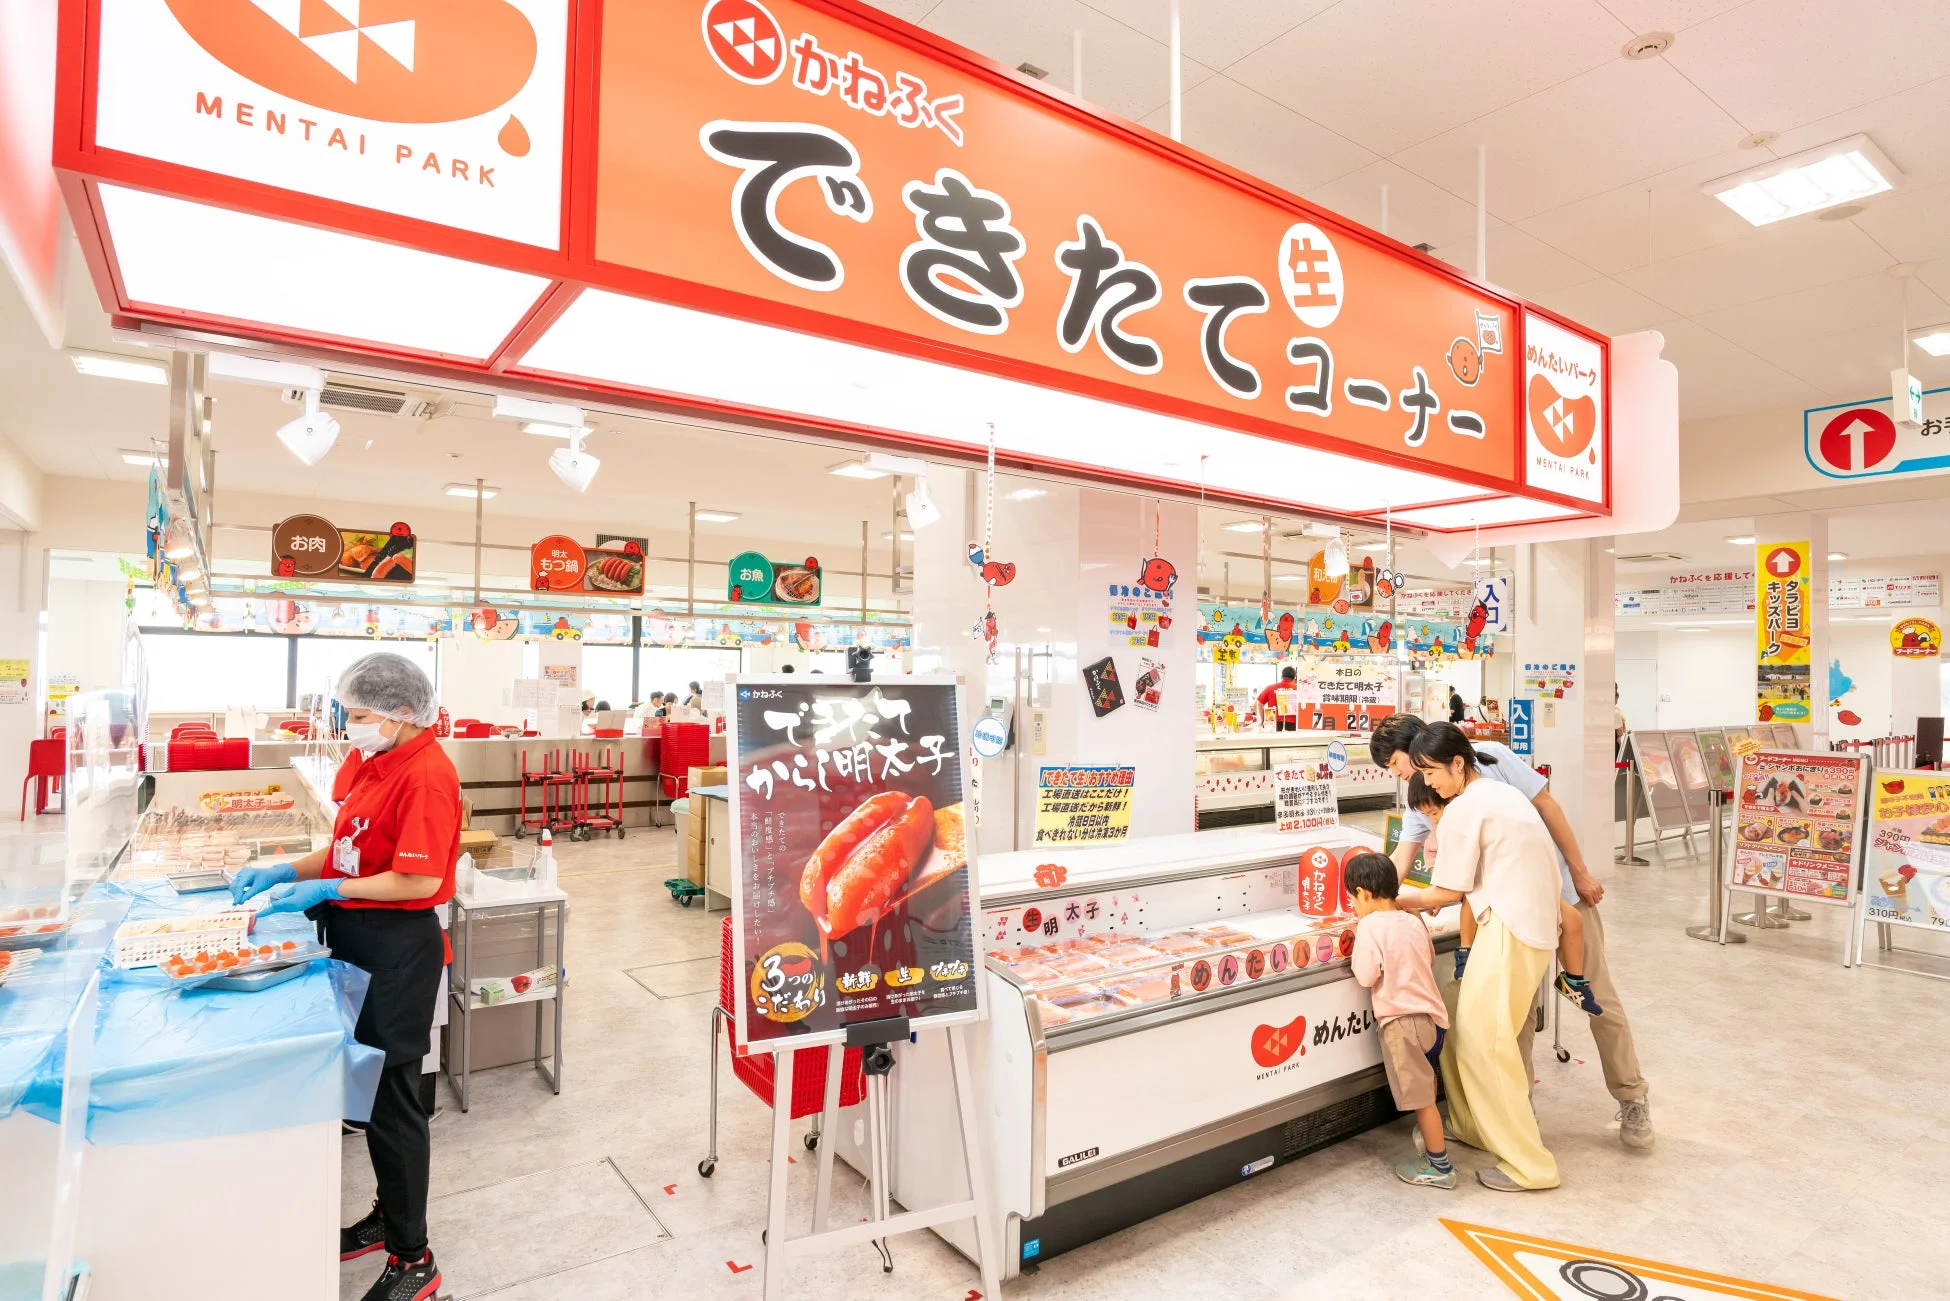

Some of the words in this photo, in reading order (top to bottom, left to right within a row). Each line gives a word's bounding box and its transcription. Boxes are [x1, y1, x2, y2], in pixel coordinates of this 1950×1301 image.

[795, 37, 963, 144] かねふく
[196, 91, 365, 155] MENTAI
[396, 144, 495, 188] PARK
[704, 124, 1267, 397] できたて
[1288, 237, 1338, 308] 生
[1526, 344, 1597, 387] めんたいパーク
[1286, 339, 1485, 445] コーナー
[1536, 456, 1566, 473] MENTAI
[1570, 466, 1590, 480] PARK
[290, 535, 326, 553] お肉
[551, 549, 568, 559] 明太
[540, 557, 579, 573] もつ鍋
[740, 568, 764, 582] お魚
[1483, 583, 1500, 625] 入口
[1767, 580, 1782, 657] キッズパーク
[1895, 647, 1937, 655] フードコーナー
[1335, 668, 1362, 677] 本日の
[752, 689, 783, 699] かねふく
[1318, 681, 1384, 692] できたて明太子
[1313, 712, 1336, 731] 7月
[1510, 703, 1529, 740] 入口
[746, 734, 956, 801] からし明太子
[1275, 769, 1305, 780] できたて
[231, 798, 266, 809] 明太子
[1042, 788, 1129, 800] 工場直送はここだけ！
[1040, 801, 1128, 813] 工場直送だから新鮮！
[1067, 814, 1110, 827] 冷蔵8日以内
[1035, 825, 1129, 842] 食べきれない分は冷凍3か月
[1879, 829, 1911, 842] 390円
[1312, 869, 1326, 912] かねふく
[1868, 907, 1899, 920] 310円
[762, 954, 814, 992] 3つの
[841, 970, 871, 990] 新鮮
[898, 966, 912, 983] 生
[755, 989, 826, 1015] こだわり
[1256, 1068, 1281, 1081] MENTAI
[1283, 1061, 1301, 1073] PARK
[1062, 1148, 1097, 1167] GALILEI
